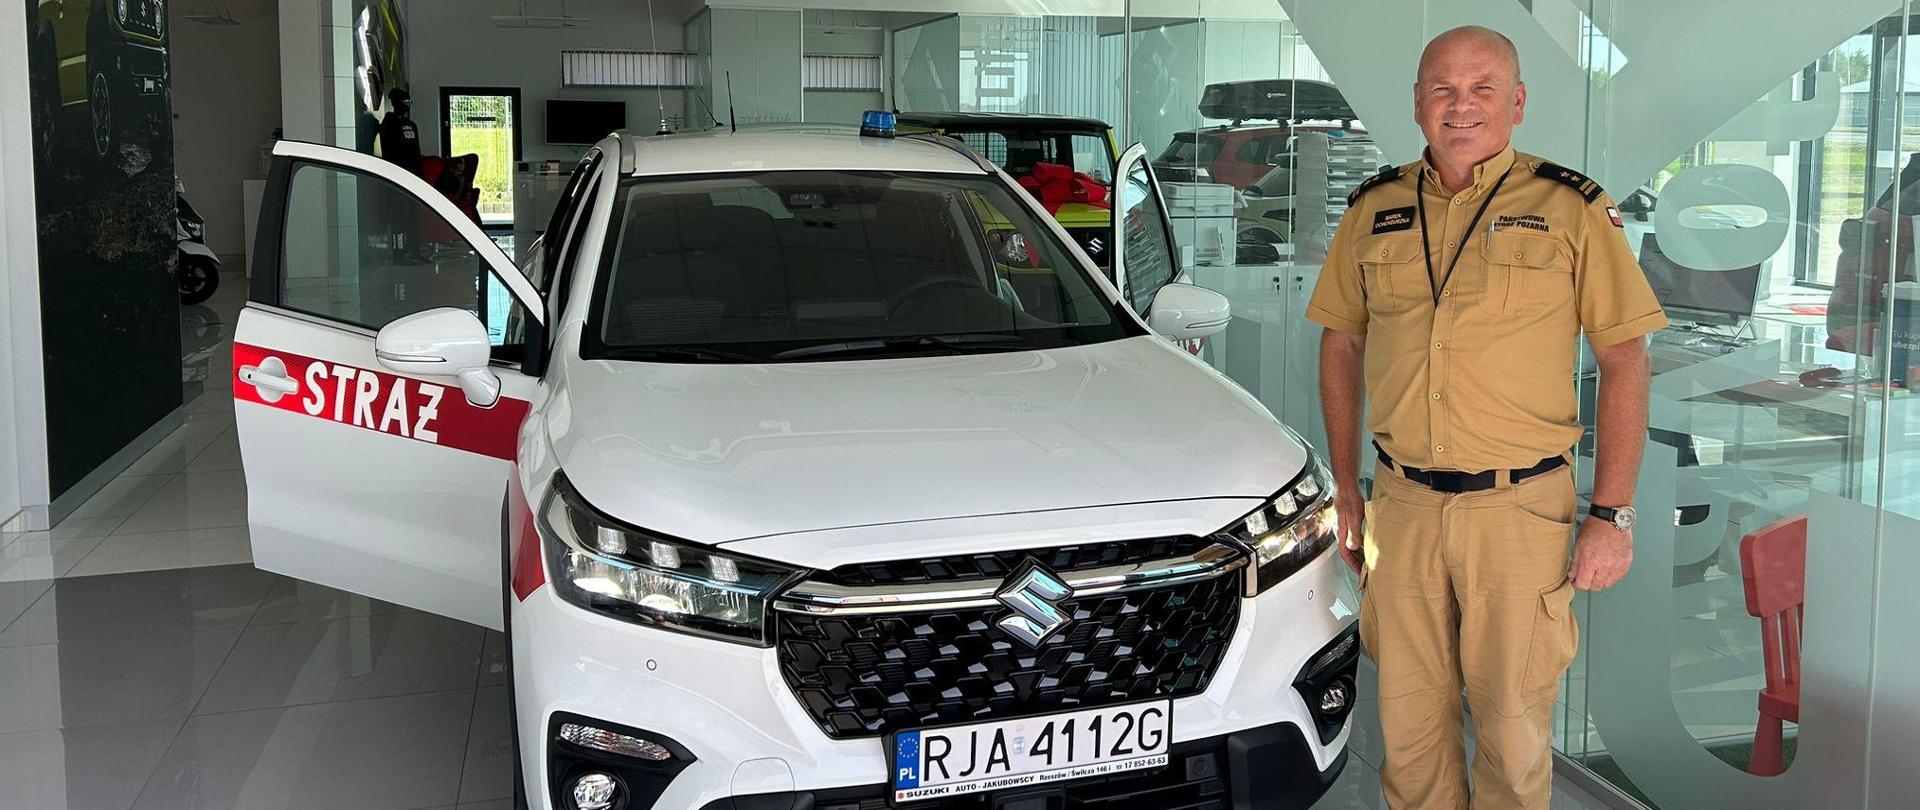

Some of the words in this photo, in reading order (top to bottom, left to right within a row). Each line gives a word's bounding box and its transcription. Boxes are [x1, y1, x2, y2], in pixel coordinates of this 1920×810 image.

[302, 361, 444, 444] STRAŻ
[923, 727, 1011, 782] RJA
[1028, 707, 1164, 766] 4112G
[899, 767, 916, 781] PL
[906, 787, 950, 798] SUZUKI
[955, 783, 977, 793] AUTO
[982, 775, 1035, 789] JAKUBOWSCY
[1039, 772, 1066, 781] Rzeszów
[1071, 767, 1095, 777] Świlcza
[1124, 761, 1132, 769] 17
[1133, 756, 1166, 767] 852-63-63
